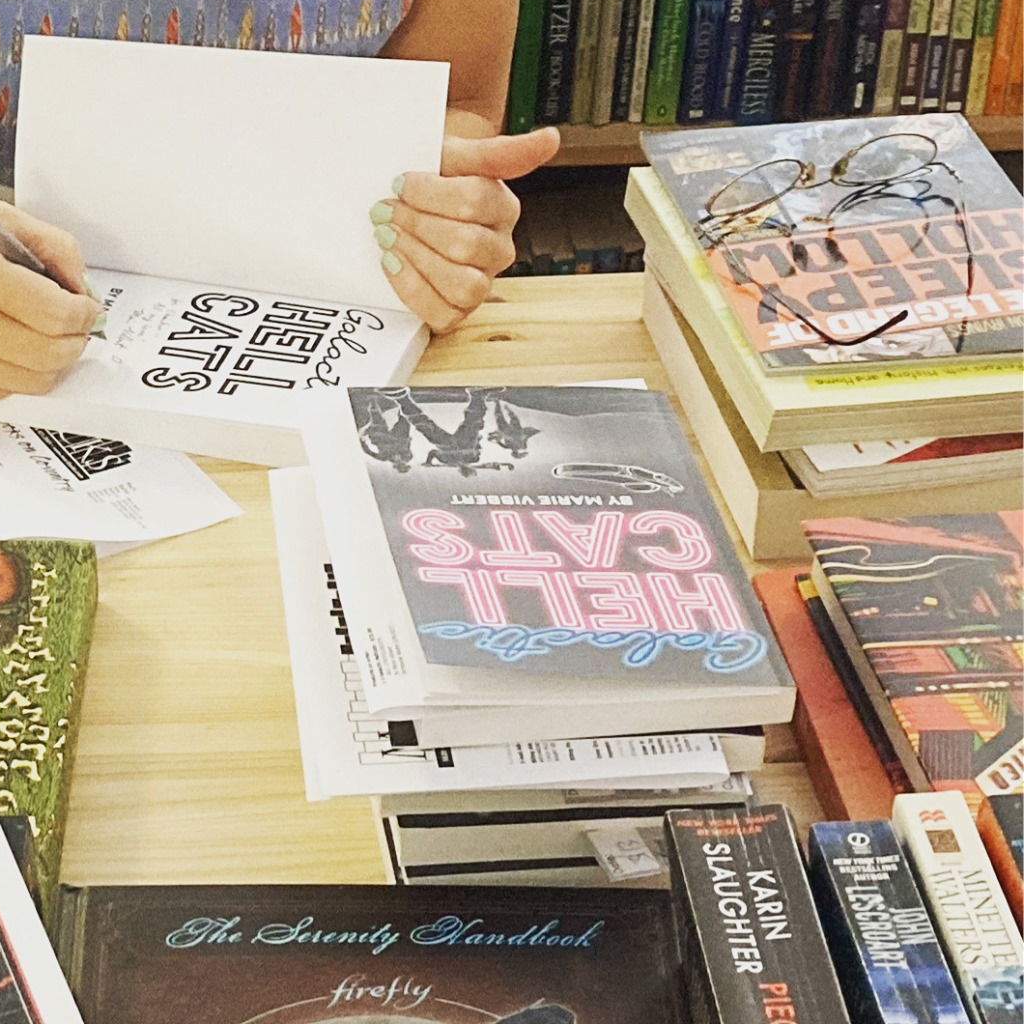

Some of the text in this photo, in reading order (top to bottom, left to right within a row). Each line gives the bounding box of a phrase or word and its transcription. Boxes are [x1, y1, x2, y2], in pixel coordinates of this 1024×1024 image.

[740, 32, 776, 117] MERCILESS
[722, 212, 1024, 286] HOLLOW
[757, 249, 1024, 324] SLEEPY
[141, 292, 260, 392] CATS
[217, 301, 340, 395] HELL
[302, 309, 385, 390] Galact
[767, 293, 999, 347] LEGEND OF
[451, 494, 633, 505] BY MARIE VIBBERT
[402, 508, 712, 570] CATS
[419, 567, 745, 632] HELL
[418, 620, 769, 674] Galactic
[677, 818, 704, 827] NEW
[709, 817, 741, 827] YORK
[832, 854, 901, 866] NEW YORK TIMES
[839, 863, 899, 874] BESTSELLING
[853, 873, 890, 882] AUTHOR
[165, 915, 605, 955] The Serenity Handbook
[702, 842, 764, 974] SLAUGHTER
[746, 869, 793, 940] KARIN
[845, 885, 910, 970] LESCROART
[889, 907, 938, 945] JOHN
[928, 869, 990, 966] WALTERS
[958, 869, 1021, 967] MINETTE
[327, 974, 434, 1010] firefly
